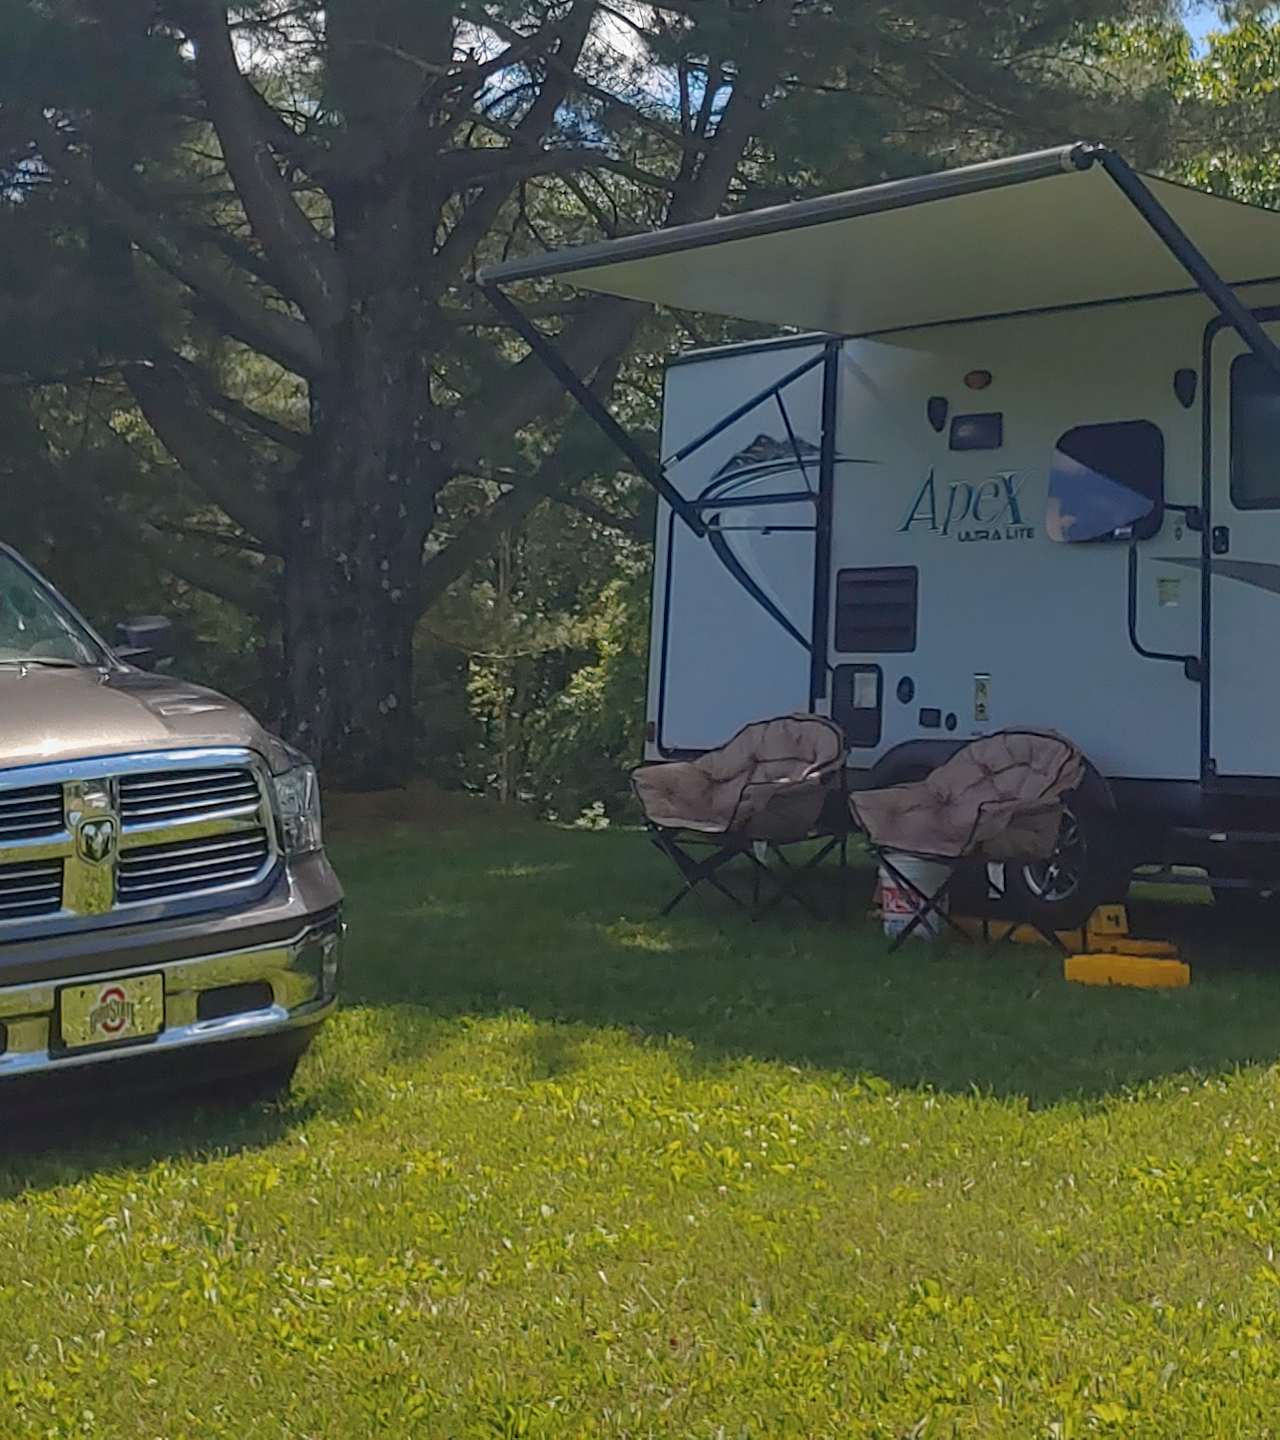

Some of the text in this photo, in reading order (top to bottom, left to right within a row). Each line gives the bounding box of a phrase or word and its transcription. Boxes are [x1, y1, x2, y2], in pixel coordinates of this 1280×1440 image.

[896, 463, 1028, 537] Apex
[957, 527, 1035, 542] ULTRA LITE
